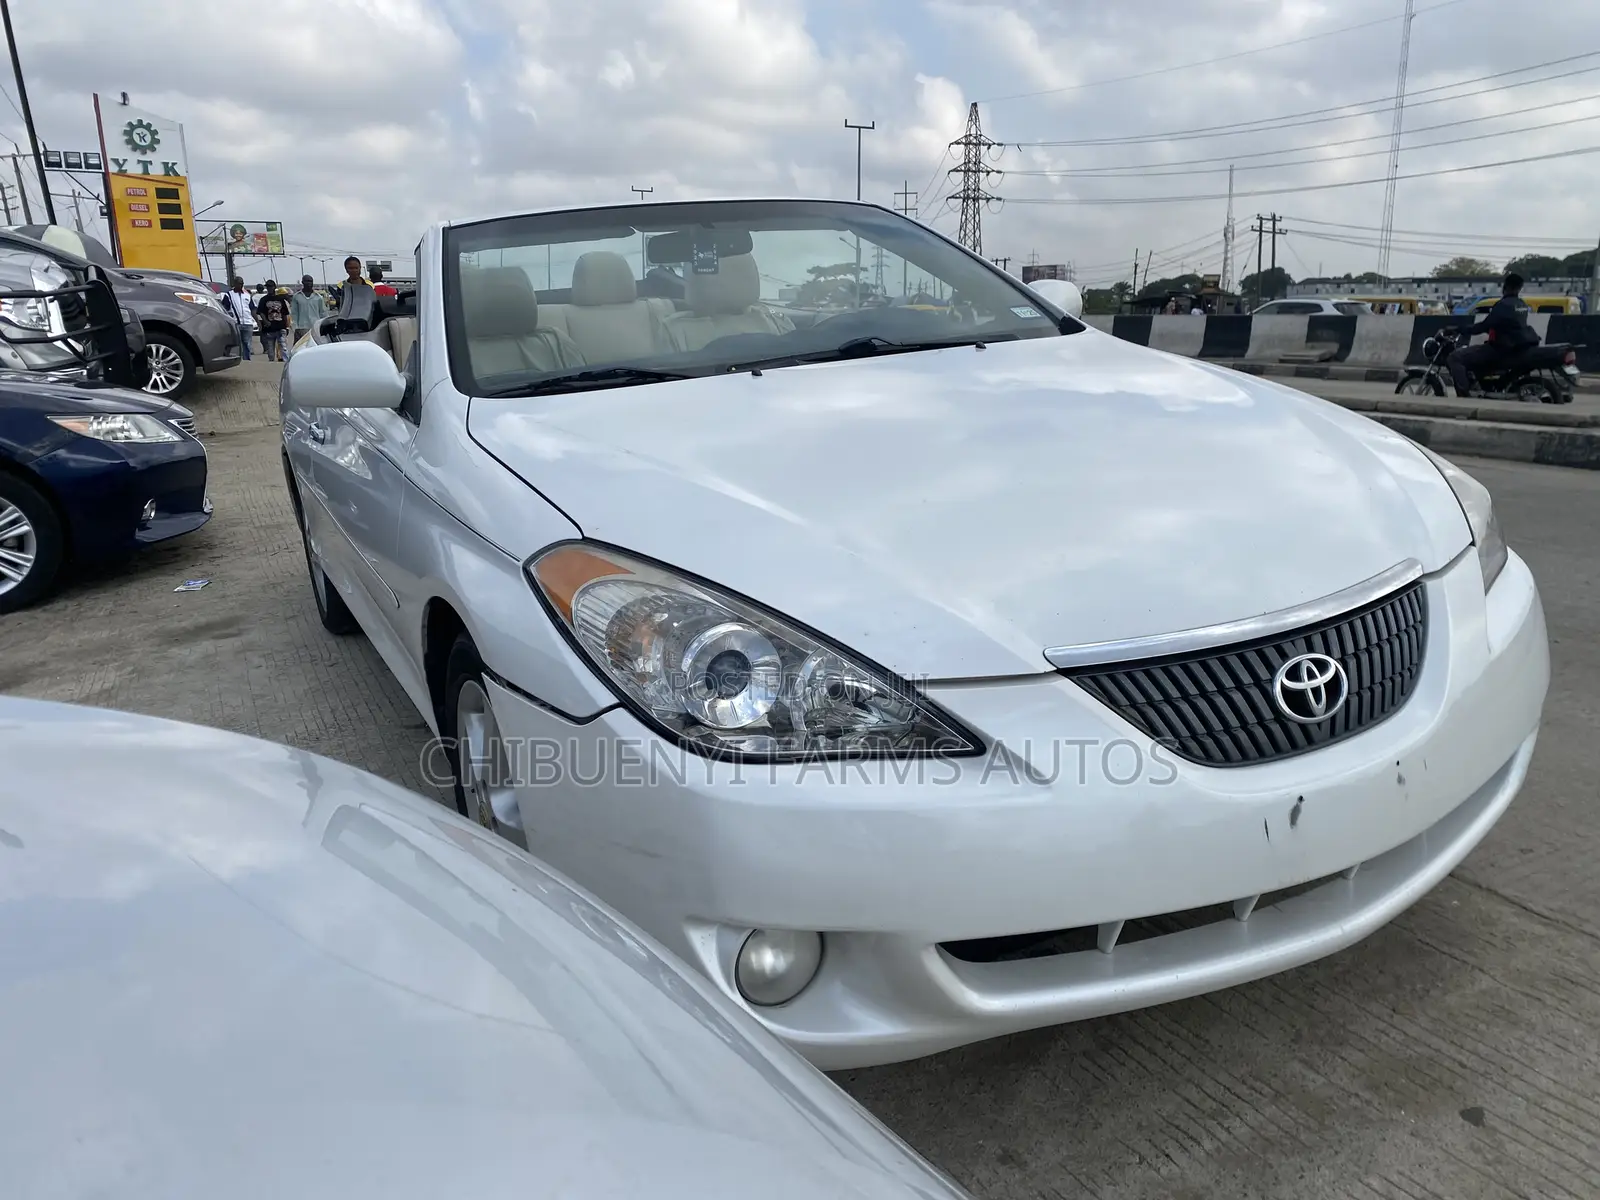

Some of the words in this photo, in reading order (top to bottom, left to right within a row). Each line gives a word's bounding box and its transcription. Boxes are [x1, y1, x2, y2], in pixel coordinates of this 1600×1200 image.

[110, 158, 181, 177] YTK
[127, 188, 147, 196] PETROL
[130, 203, 149, 212] DIESEL
[135, 219, 149, 227] KERO
